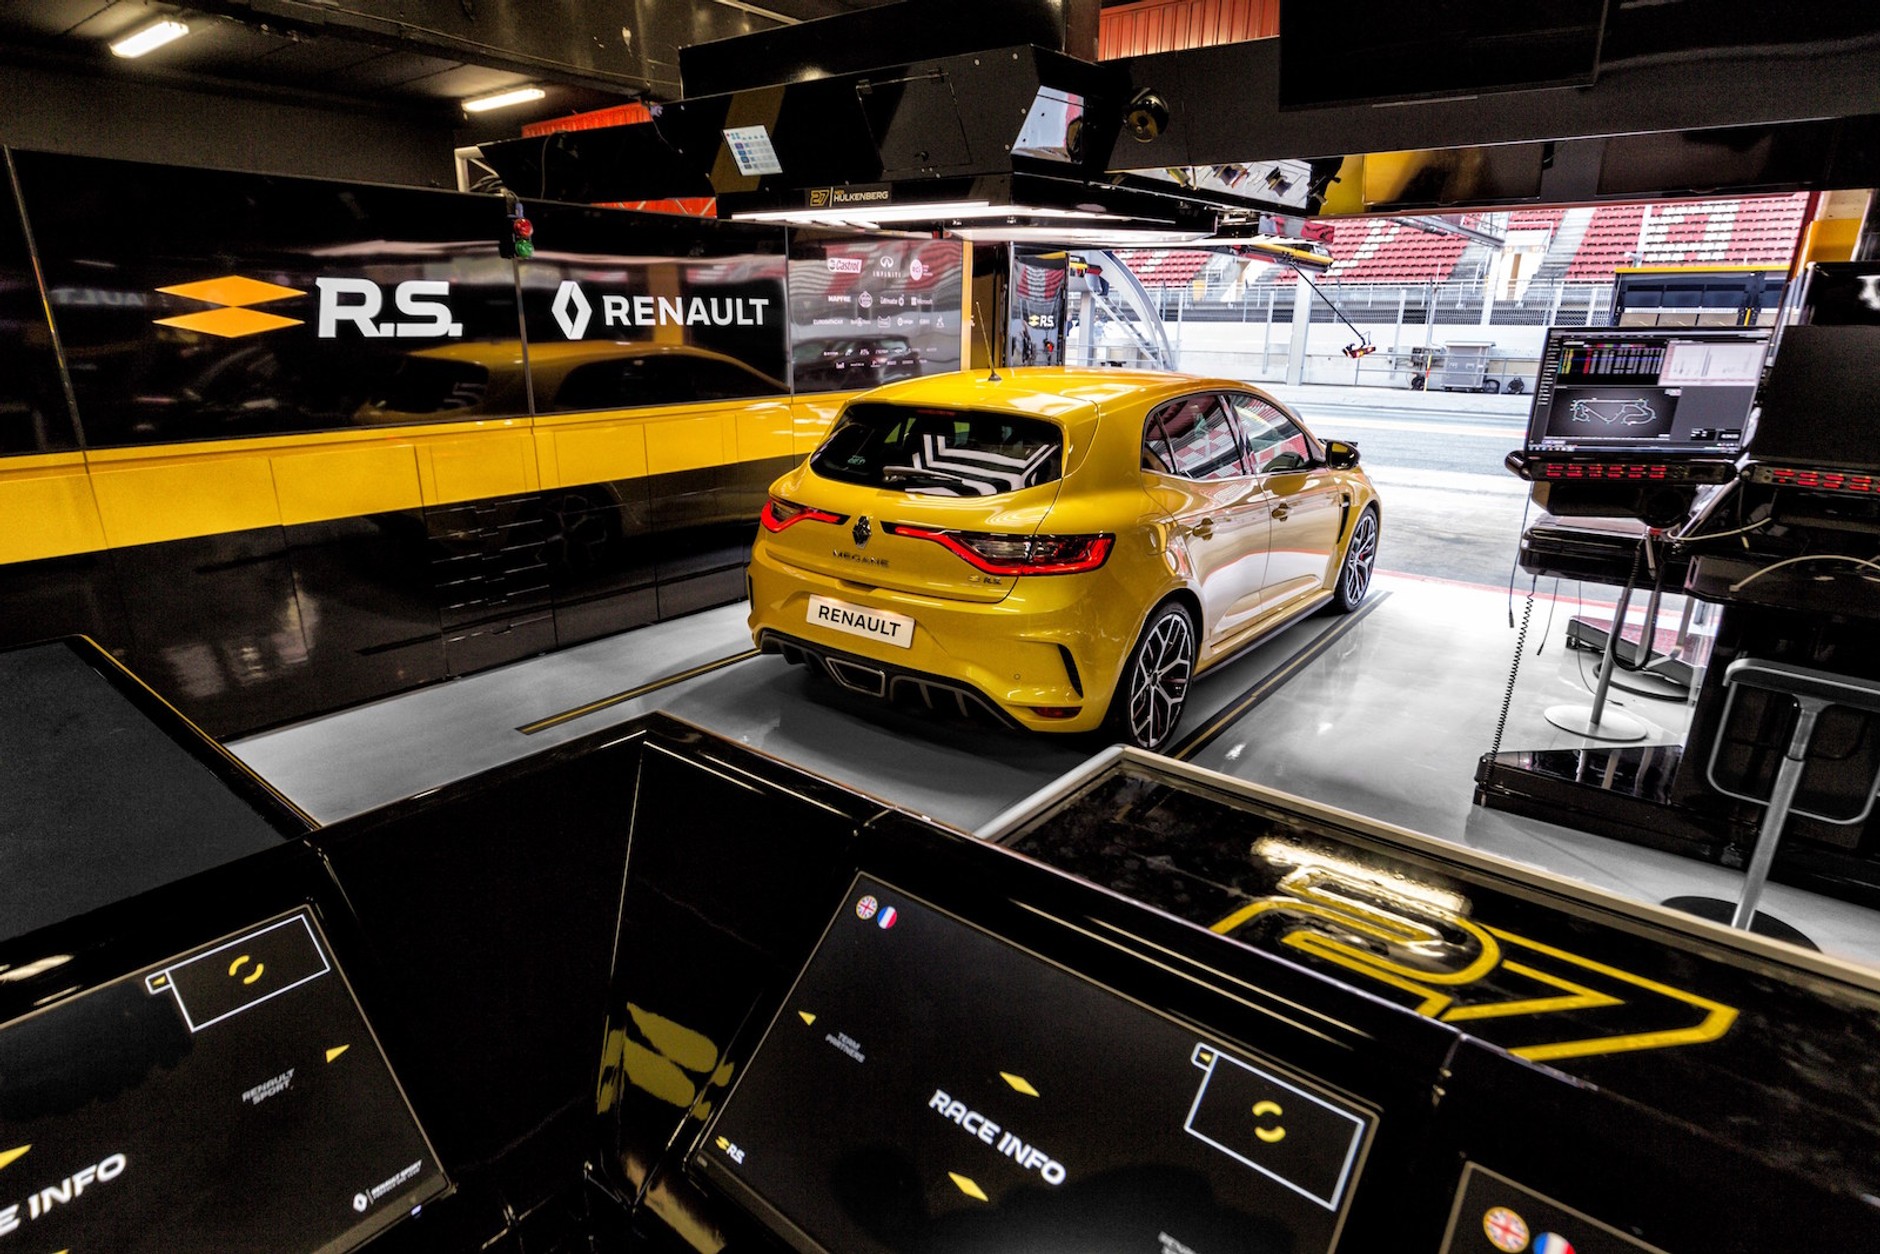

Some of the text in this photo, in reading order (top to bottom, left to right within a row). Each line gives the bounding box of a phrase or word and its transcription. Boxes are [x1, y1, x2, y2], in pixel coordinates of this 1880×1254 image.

[836, 260, 860, 271] Castrol
[315, 277, 463, 338] R.S.
[602, 295, 770, 326] RENAULT
[818, 605, 901, 637] RENAULT
[241, 1067, 295, 1102] RENAULT
[928, 1089, 1067, 1185] RACE INFO
[28, 1153, 126, 1221] INFO
